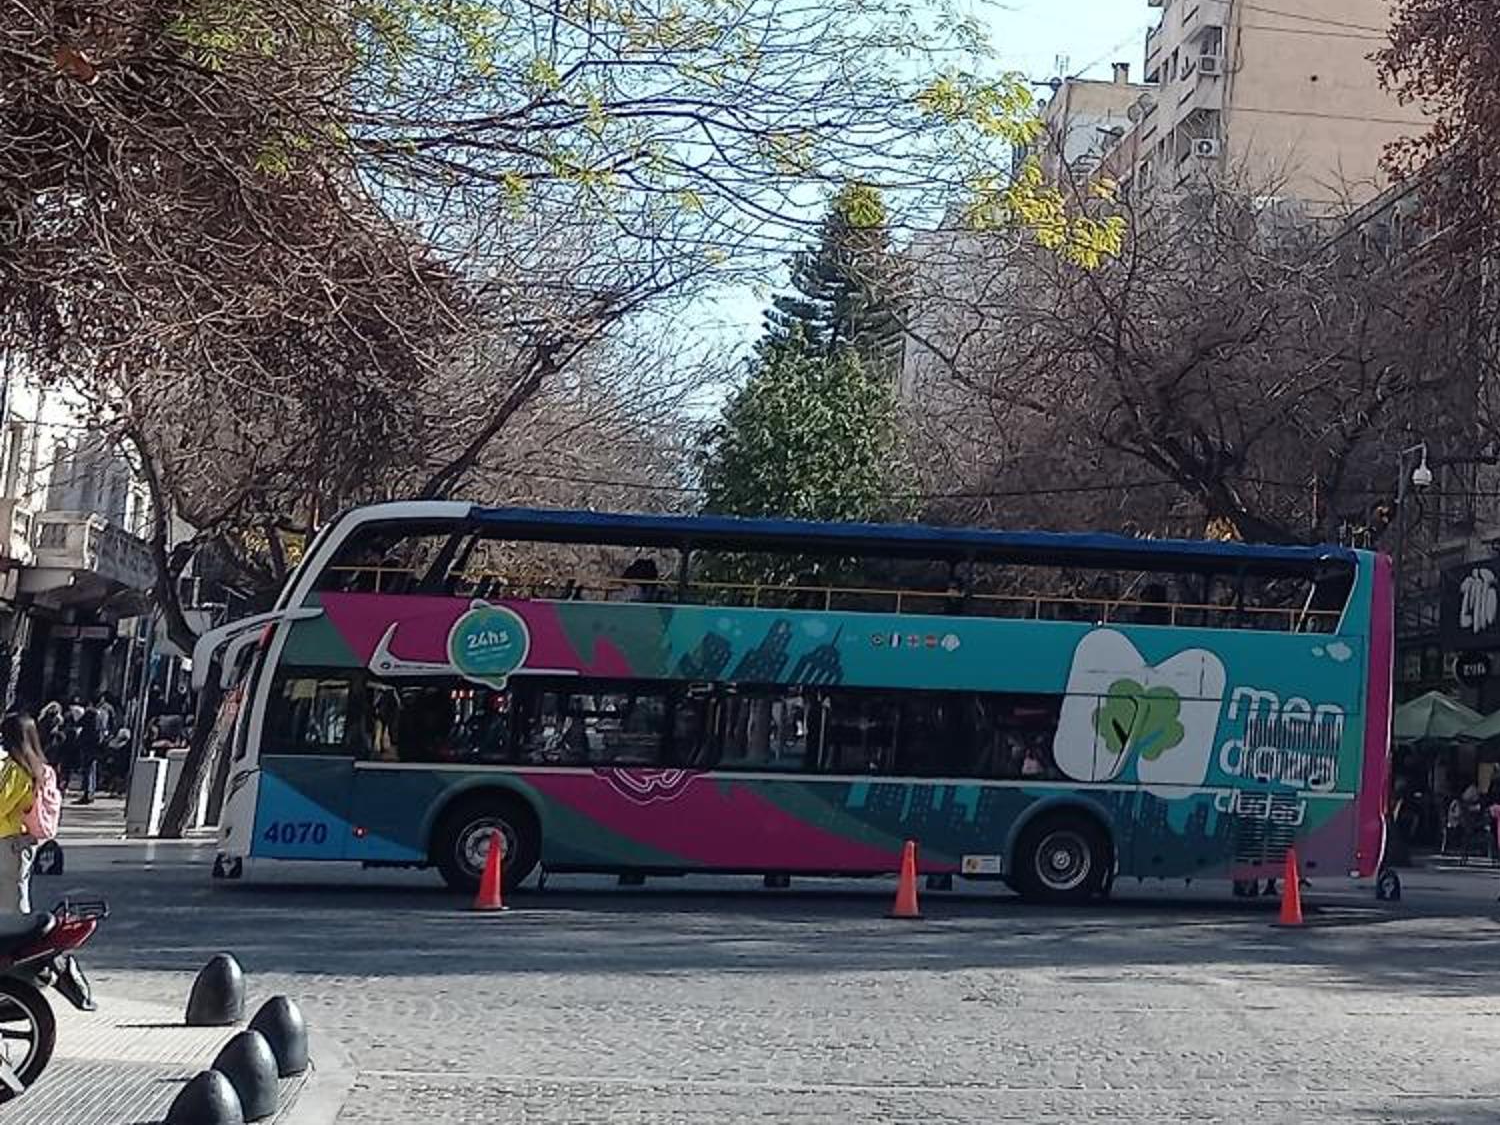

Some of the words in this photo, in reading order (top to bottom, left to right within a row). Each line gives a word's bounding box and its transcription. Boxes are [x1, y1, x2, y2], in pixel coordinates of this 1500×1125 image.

[467, 630, 510, 649] 24hs
[1227, 686, 1345, 733] men
[263, 821, 328, 844] 4070
